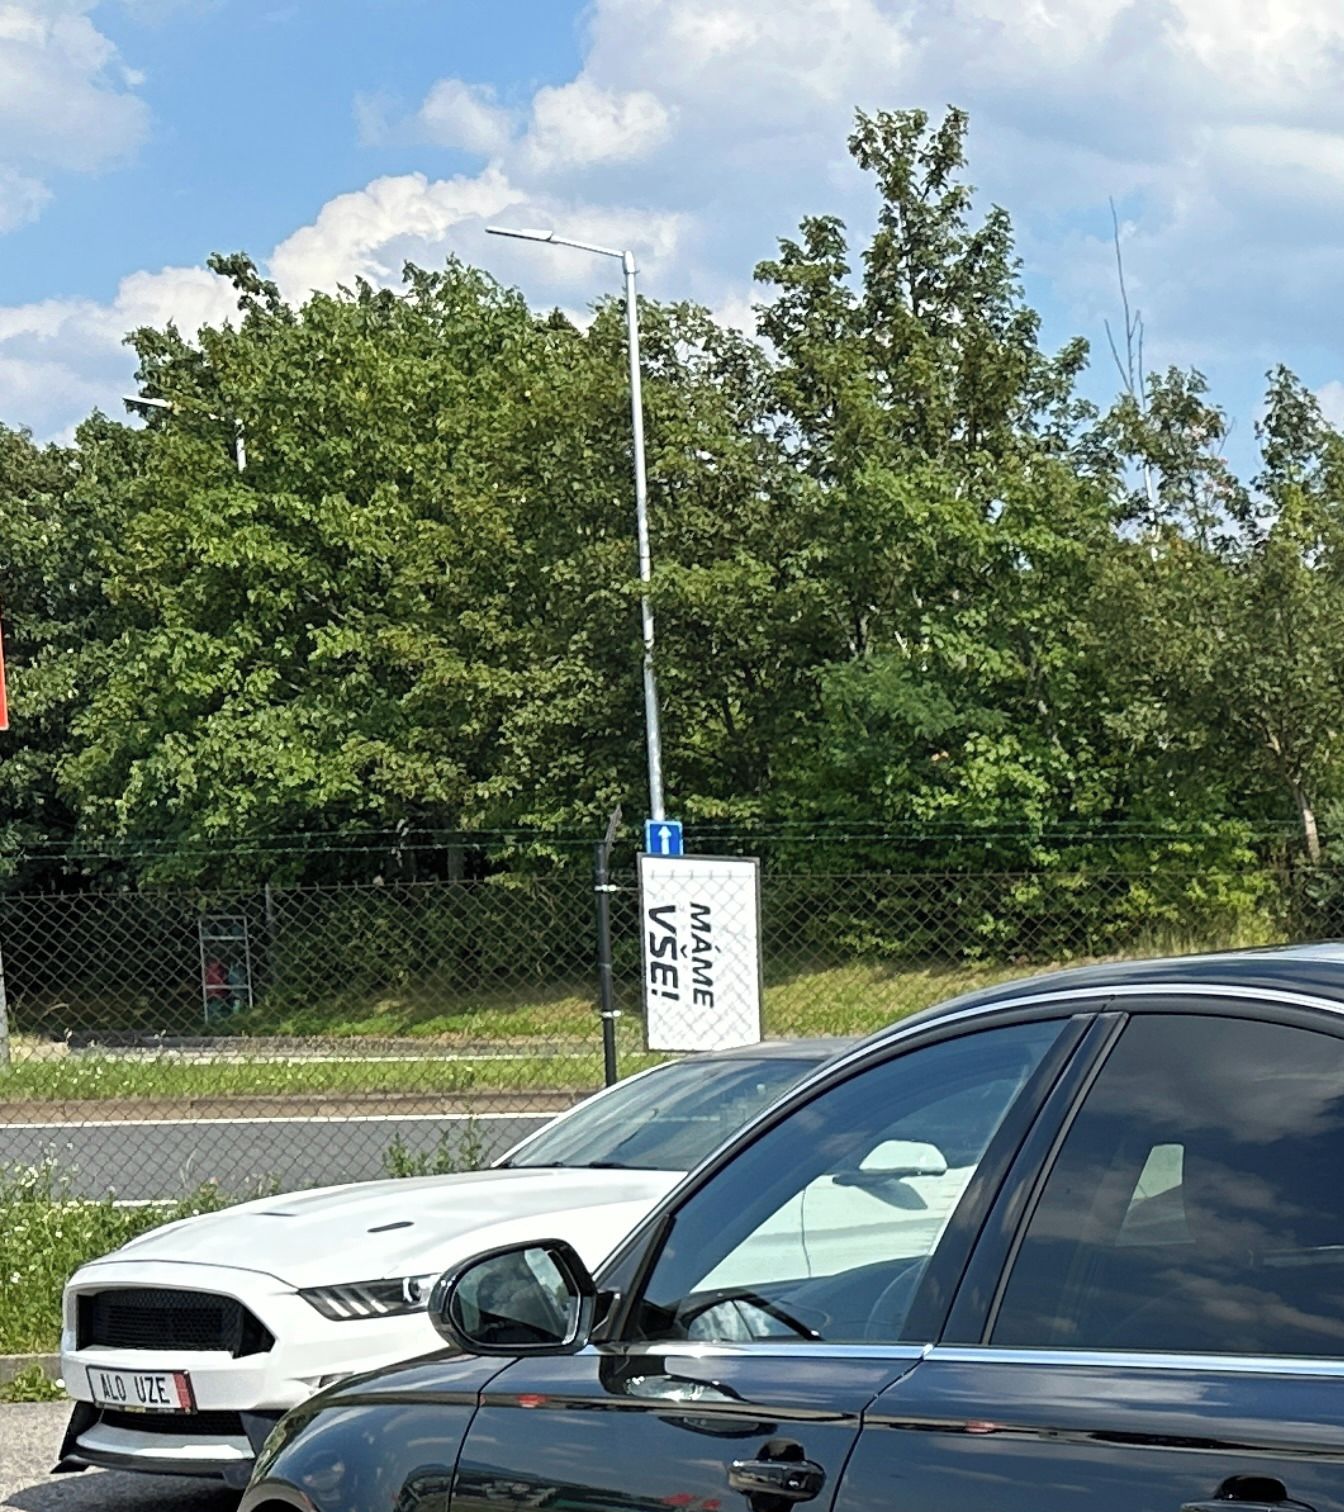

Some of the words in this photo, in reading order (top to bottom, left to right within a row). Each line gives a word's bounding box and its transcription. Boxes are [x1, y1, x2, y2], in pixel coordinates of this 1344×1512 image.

[648, 905, 688, 1001] VŠE!
[690, 902, 721, 1008] MÁME
[134, 1375, 170, 1404] UZE
